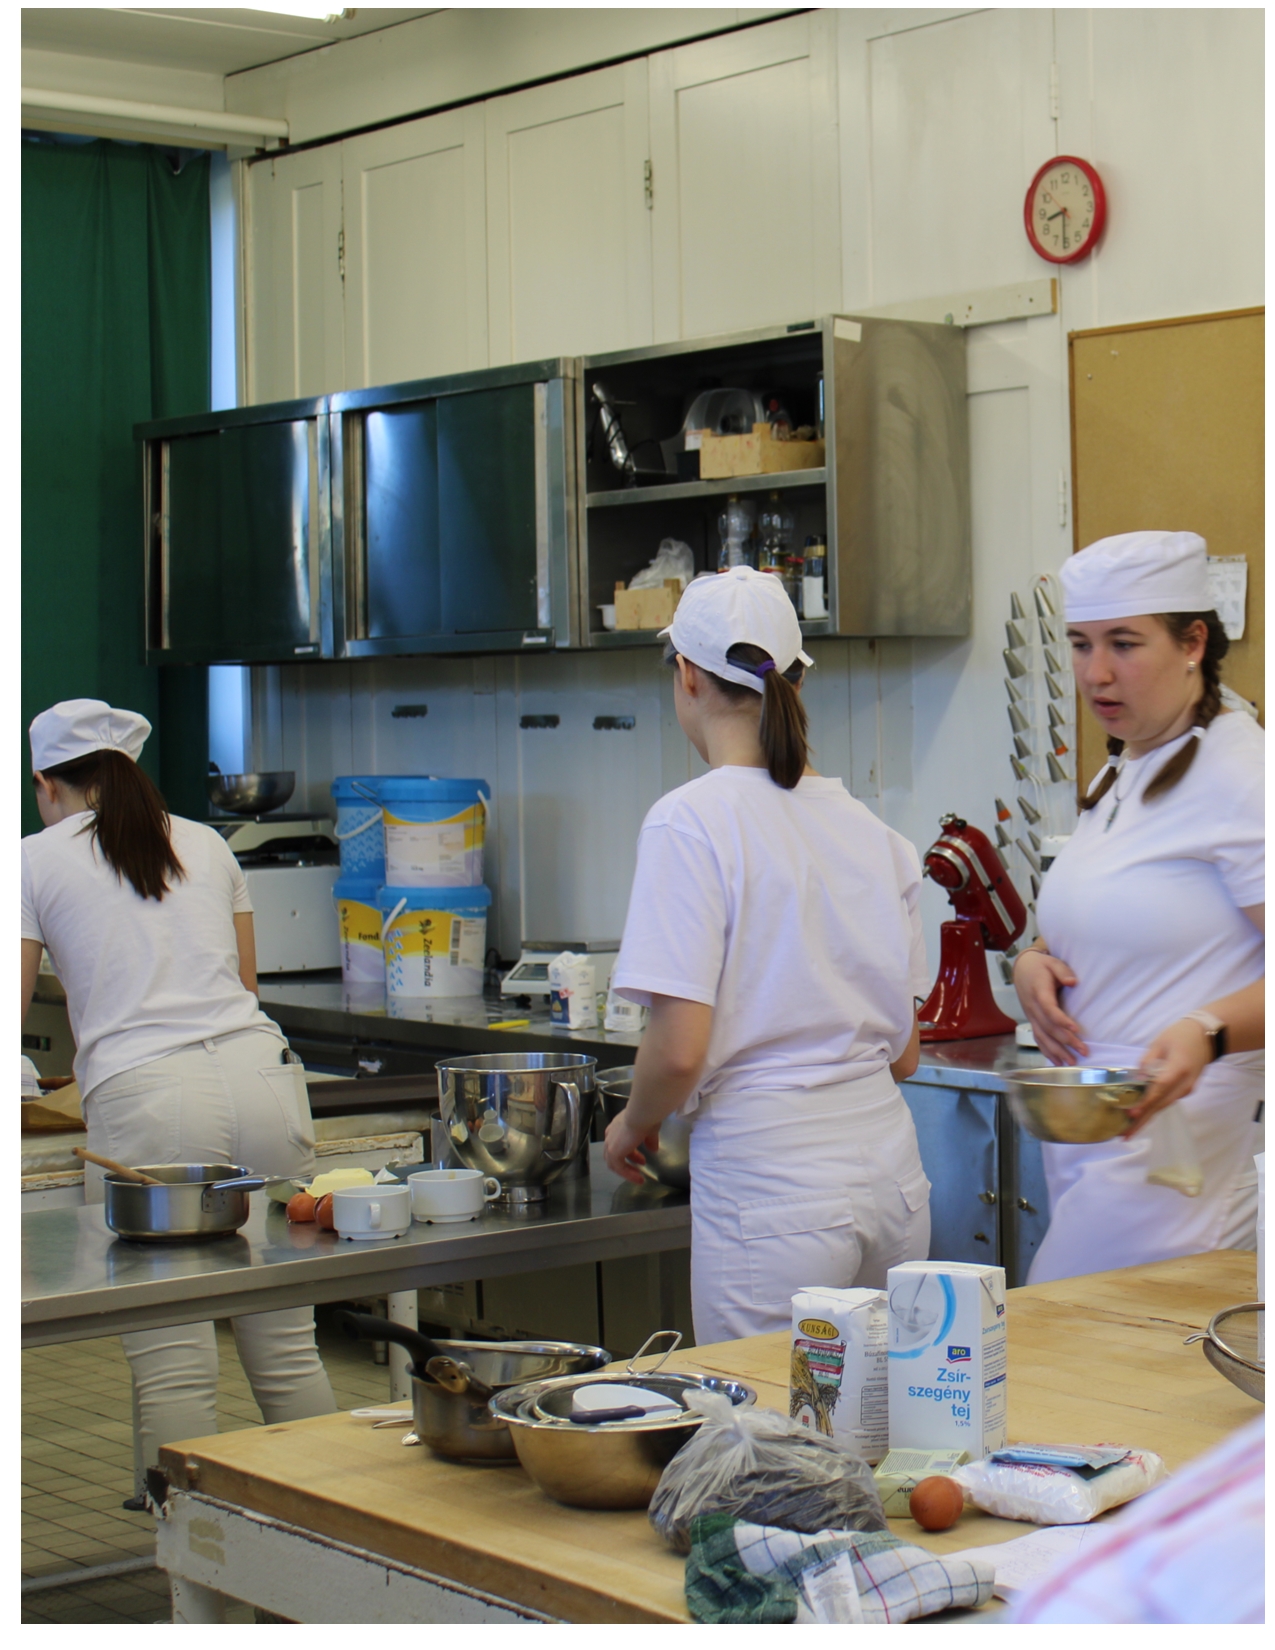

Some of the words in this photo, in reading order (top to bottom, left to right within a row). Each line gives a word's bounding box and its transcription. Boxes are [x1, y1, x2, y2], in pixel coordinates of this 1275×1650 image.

[1050, 179, 1058, 191] 11
[1061, 172, 1070, 184] 12
[1082, 185, 1089, 196] 2
[1039, 209, 1046, 220] 9
[1087, 201, 1093, 213] 3
[1043, 223, 1050, 235] 8
[1082, 217, 1089, 228] 4
[1053, 235, 1059, 246] 7
[1074, 231, 1082, 243] 5
[357, 932, 380, 942] Fond
[423, 938, 434, 988] Zeelandia
[800, 1322, 836, 1337] KUNSÁGI
[951, 1348, 967, 1356] aro
[936, 1367, 972, 1383] Zsír-
[908, 1385, 971, 1403] szegény
[951, 1403, 971, 1420] tej
[954, 1420, 971, 1428] 1,5%
